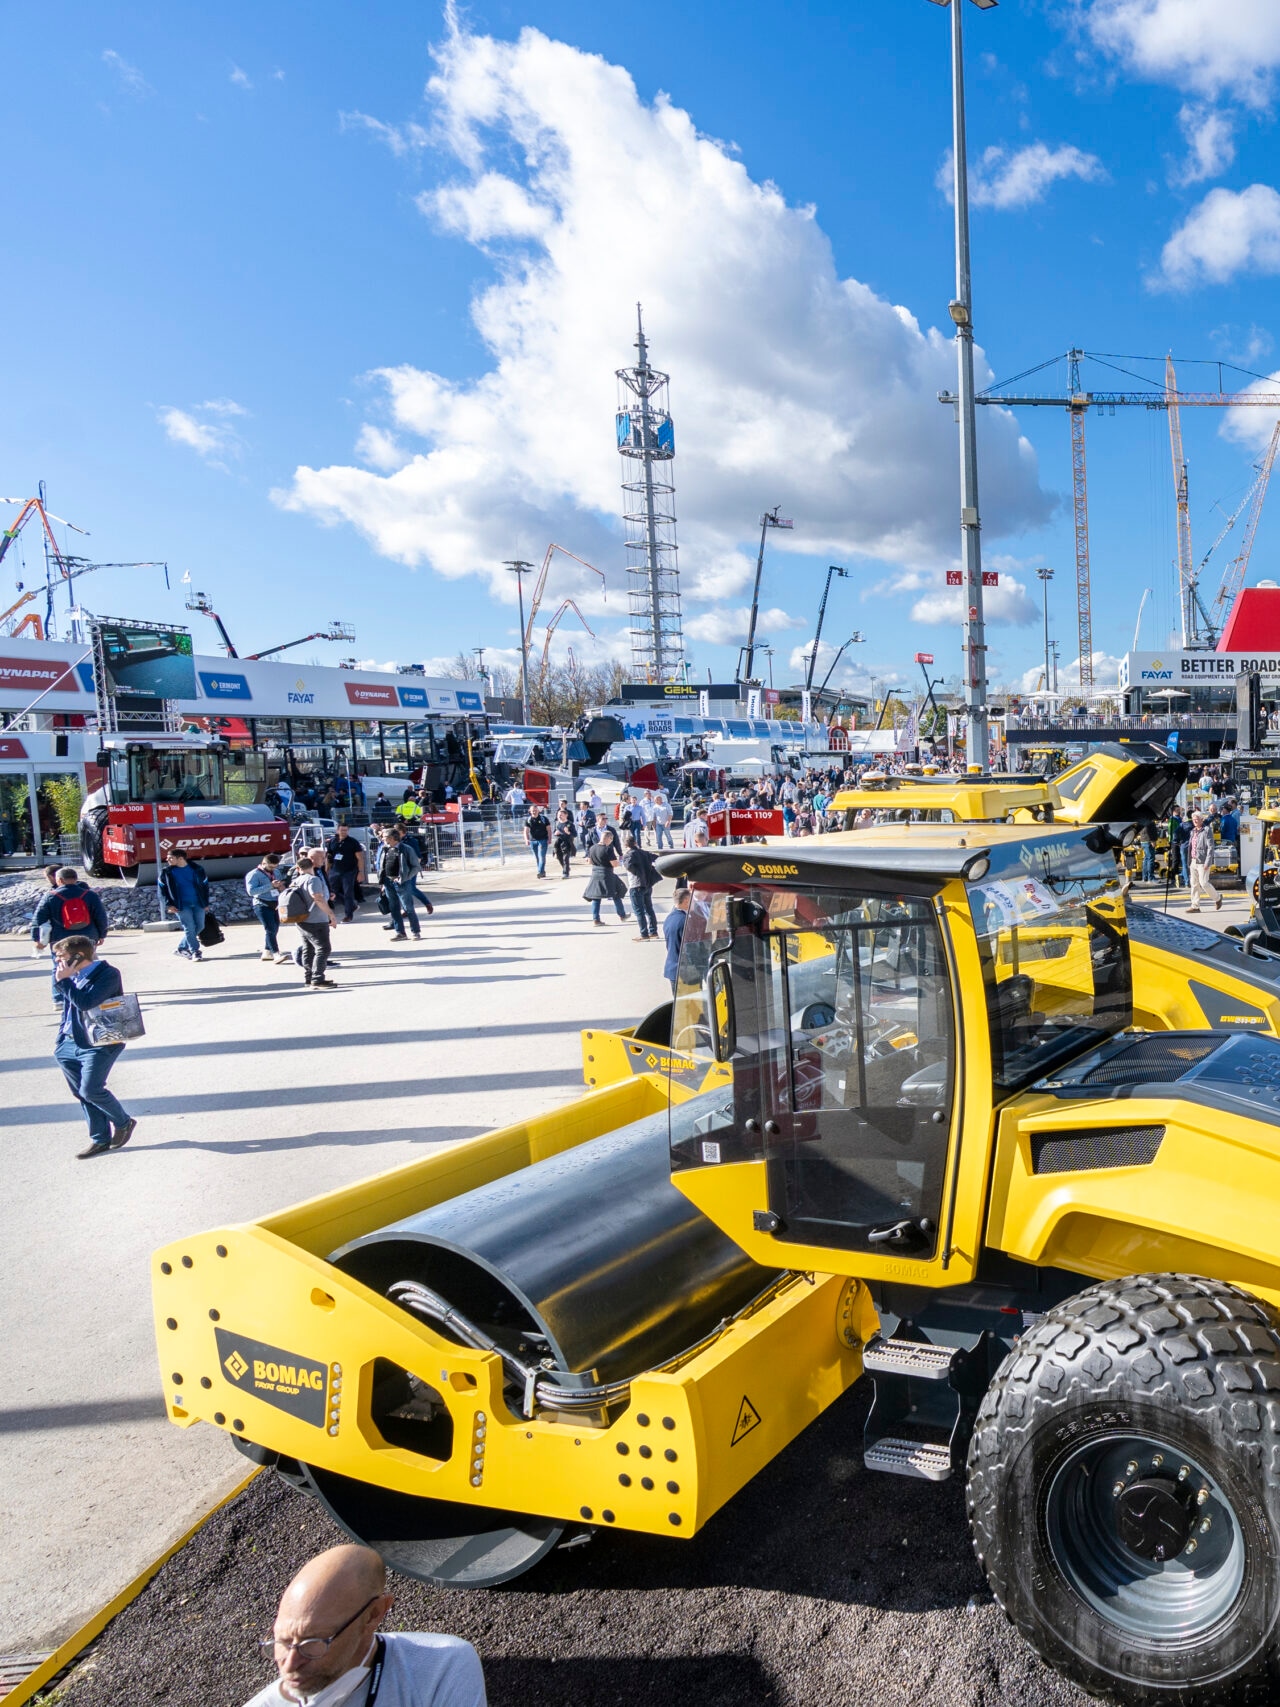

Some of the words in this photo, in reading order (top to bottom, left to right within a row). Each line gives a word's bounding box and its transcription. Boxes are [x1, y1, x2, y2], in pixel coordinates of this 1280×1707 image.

[986, 578, 997, 586] 124
[1181, 659, 1235, 673] BETTER
[1141, 670, 1173, 680] FAYAT
[663, 686, 697, 694] GEHL
[287, 692, 315, 704] FAYAT
[731, 811, 753, 819] Block
[754, 811, 773, 819] 1109
[175, 833, 272, 847] DYNAPAC
[757, 864, 799, 875] BOMAG
[660, 1056, 696, 1070] BOMAG
[253, 1359, 323, 1391] BOMAG
[254, 1380, 276, 1392] FAYAT
[276, 1384, 300, 1396] GROUP
